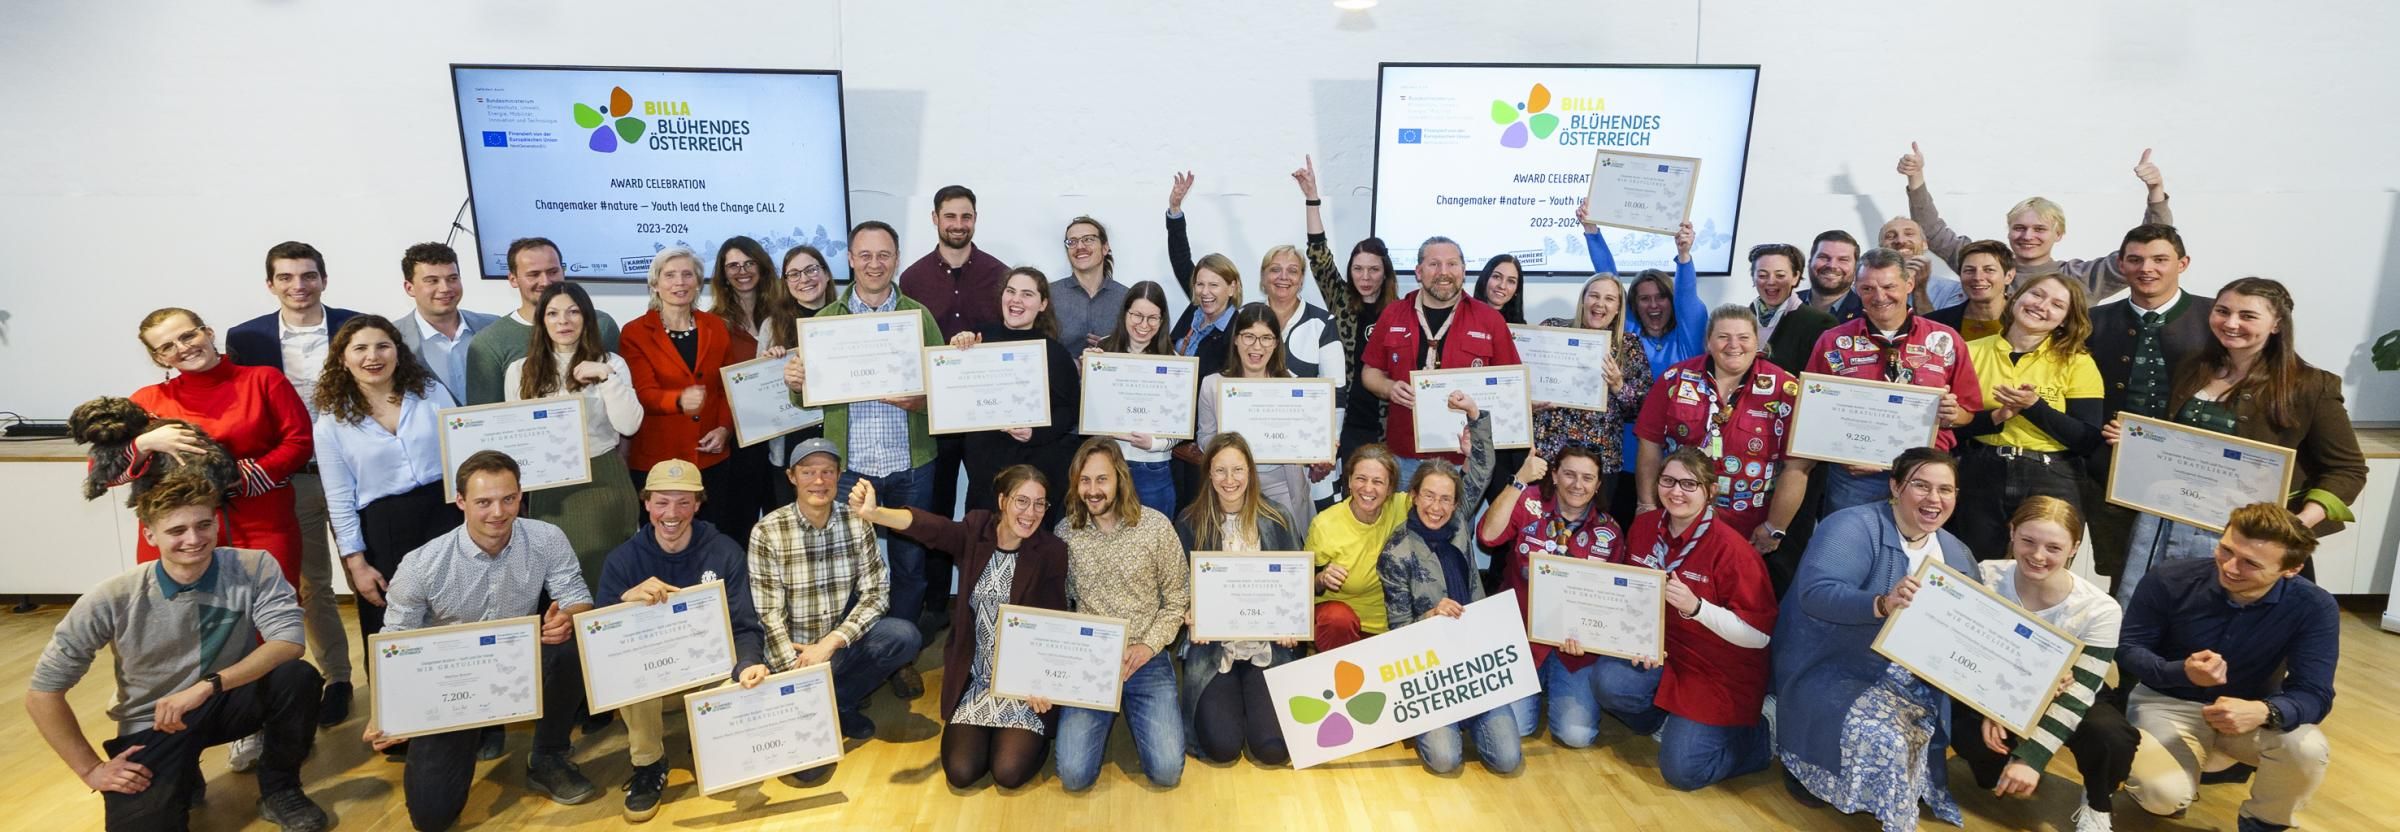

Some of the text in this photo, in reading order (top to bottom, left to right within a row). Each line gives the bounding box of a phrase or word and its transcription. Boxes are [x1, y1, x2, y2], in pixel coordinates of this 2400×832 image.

[643, 100, 692, 116] BILLA
[1561, 97, 1606, 111] BILLA
[657, 117, 750, 136] BLÜHENDES
[1570, 113, 1661, 130] BLÜHENDES
[649, 131, 743, 152] ÖSTERREICH
[1559, 128, 1651, 146] ÖSTERREICH
[610, 178, 706, 190] AWARD CELEBRATION
[1513, 173, 1590, 184] AWARD CELEBRAT
[535, 199, 597, 212] Changemaker
[600, 200, 638, 211] #nature
[651, 201, 677, 212] Youth
[680, 201, 700, 212] lead
[702, 202, 718, 212] the
[720, 202, 754, 215] Change
[756, 203, 777, 213] CALL
[779, 203, 785, 213] 2
[1436, 195, 1496, 208] Changemaker
[1499, 195, 1536, 206] #nature
[1549, 195, 1574, 206] Youth
[636, 223, 689, 234] 2023-2024
[1530, 217, 1580, 228] 2023-2024
[1379, 648, 1441, 683] BILLA
[1400, 645, 1519, 700] BLÜHENDES
[1393, 668, 1514, 723] ÖSTERREICH
